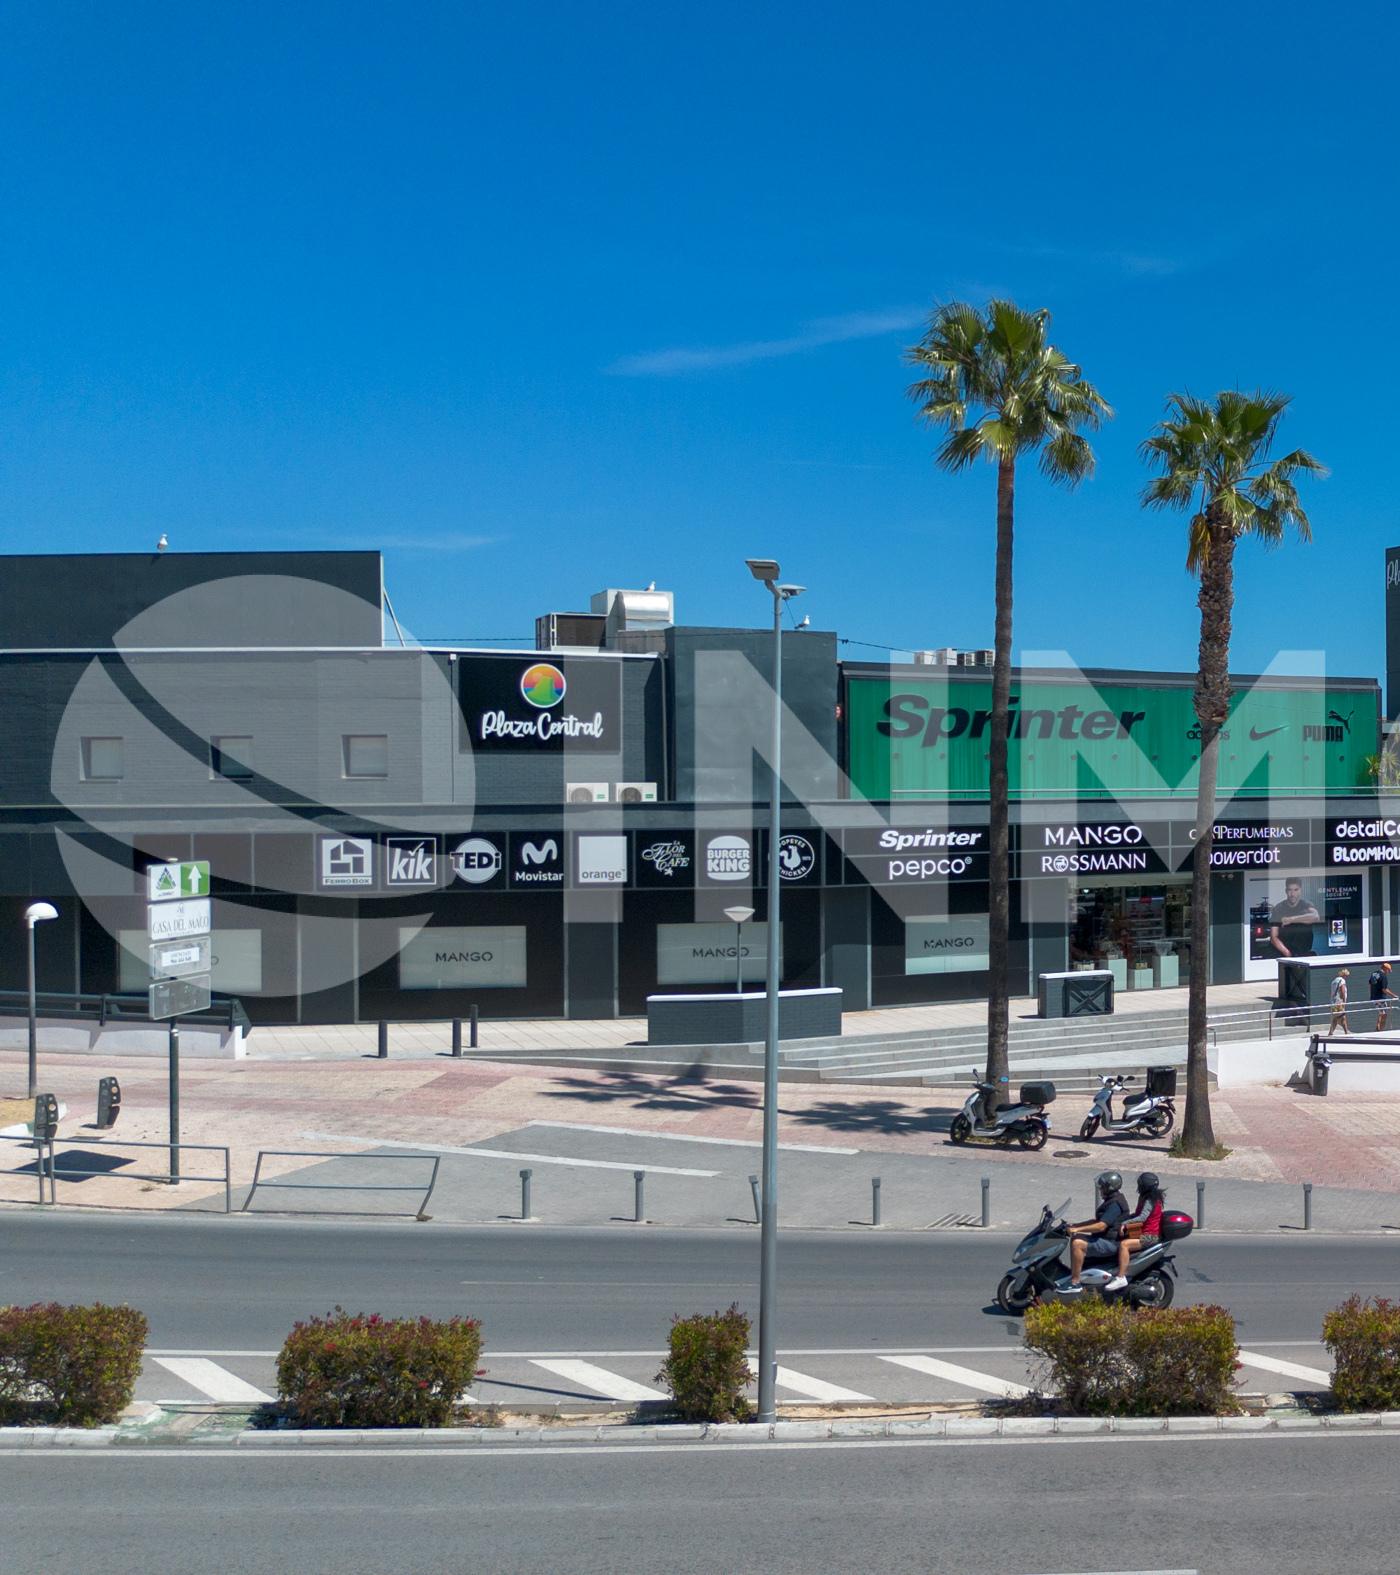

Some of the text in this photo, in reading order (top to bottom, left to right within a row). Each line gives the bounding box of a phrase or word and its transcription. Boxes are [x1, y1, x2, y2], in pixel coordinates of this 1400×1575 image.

[481, 710, 604, 740] Plaza Central
[876, 694, 1146, 748] Sprinter
[1303, 725, 1344, 742] PUMA
[879, 829, 982, 851] Sprinter
[1045, 825, 1142, 846] MANGO
[779, 839, 806, 849] OPEYES
[391, 841, 433, 880] kik
[707, 849, 750, 859] BURGER
[707, 859, 750, 872] KING
[1042, 852, 1146, 873] ROSSMANN
[515, 871, 564, 881] Movistar
[582, 872, 623, 881] orange
[924, 937, 975, 949] MANGO
[435, 951, 494, 963] MANGO
[692, 946, 750, 958] MANGO
